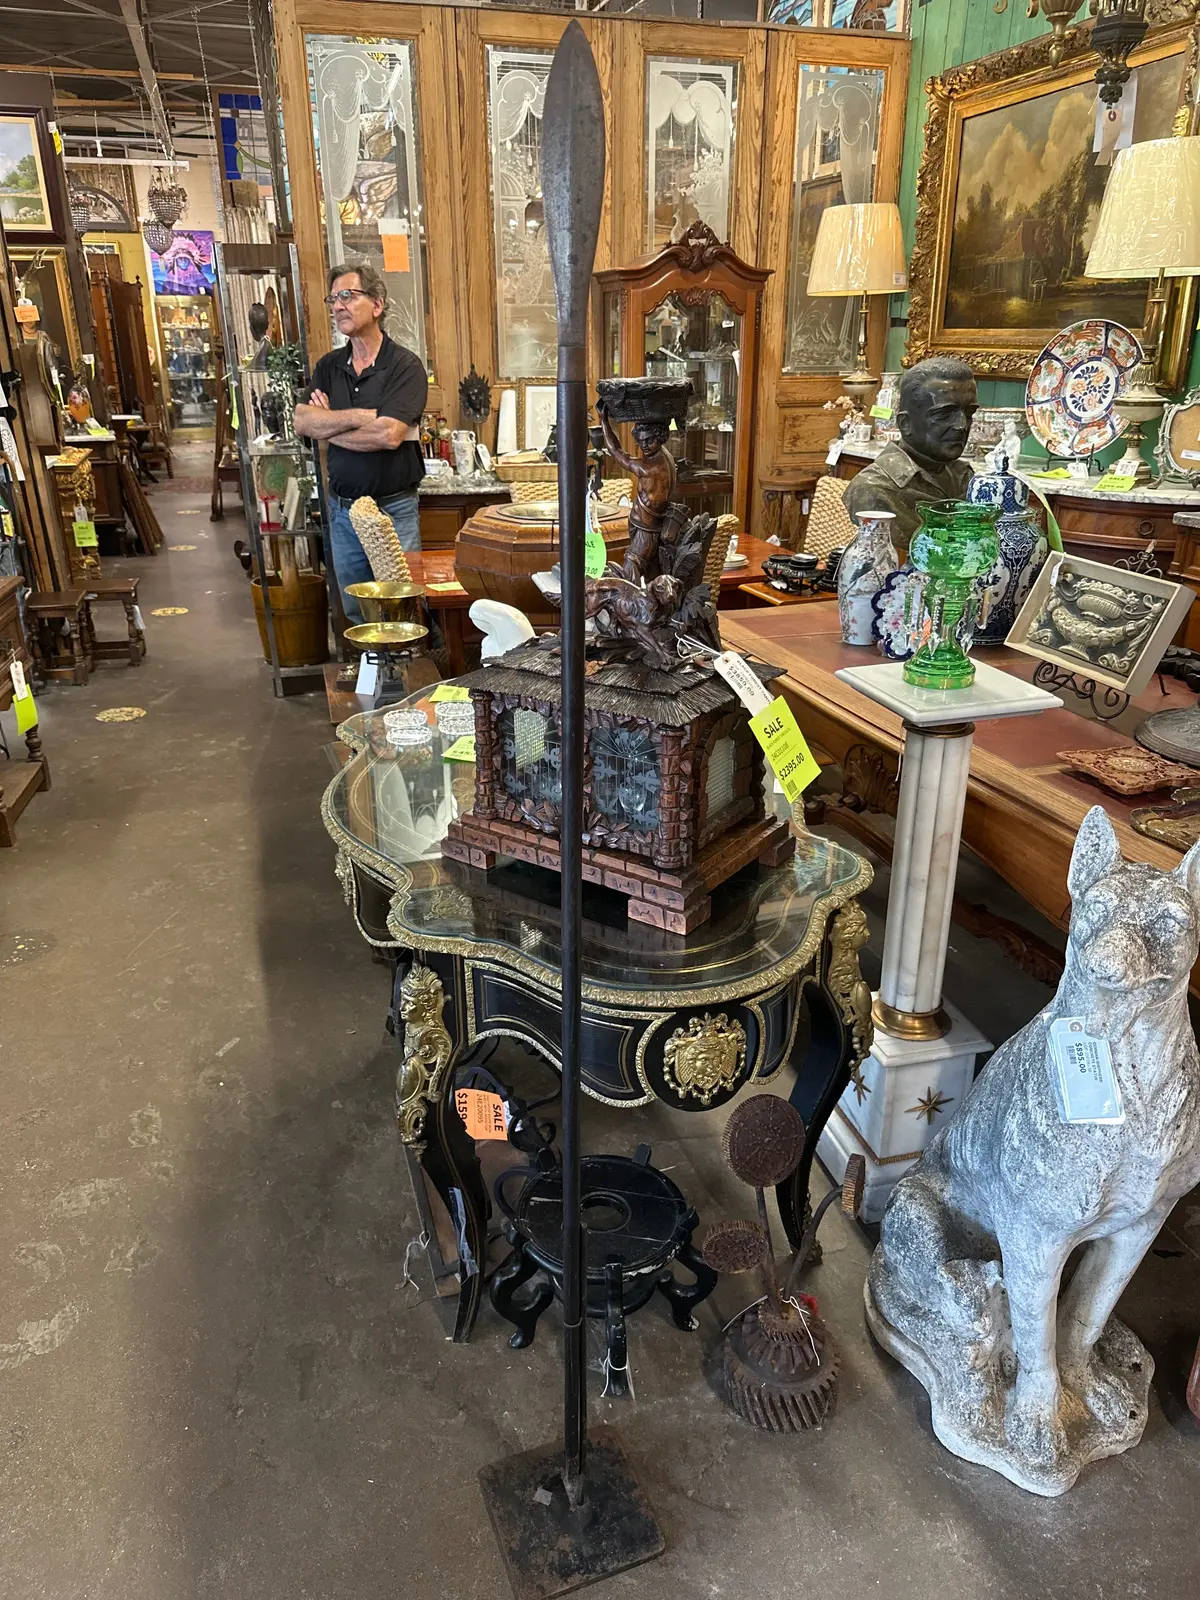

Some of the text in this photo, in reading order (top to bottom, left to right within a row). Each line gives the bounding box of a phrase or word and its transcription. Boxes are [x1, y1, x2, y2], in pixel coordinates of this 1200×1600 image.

[585, 540, 596, 548] ALE
[763, 717, 784, 739] SALE
[778, 752, 805, 781] $2395.00
[1074, 1042, 1087, 1074] $895.00
[1087, 1042, 1095, 1064] CONCRETE
[456, 1092, 468, 1130] $159
[492, 1103, 503, 1132] SALE
